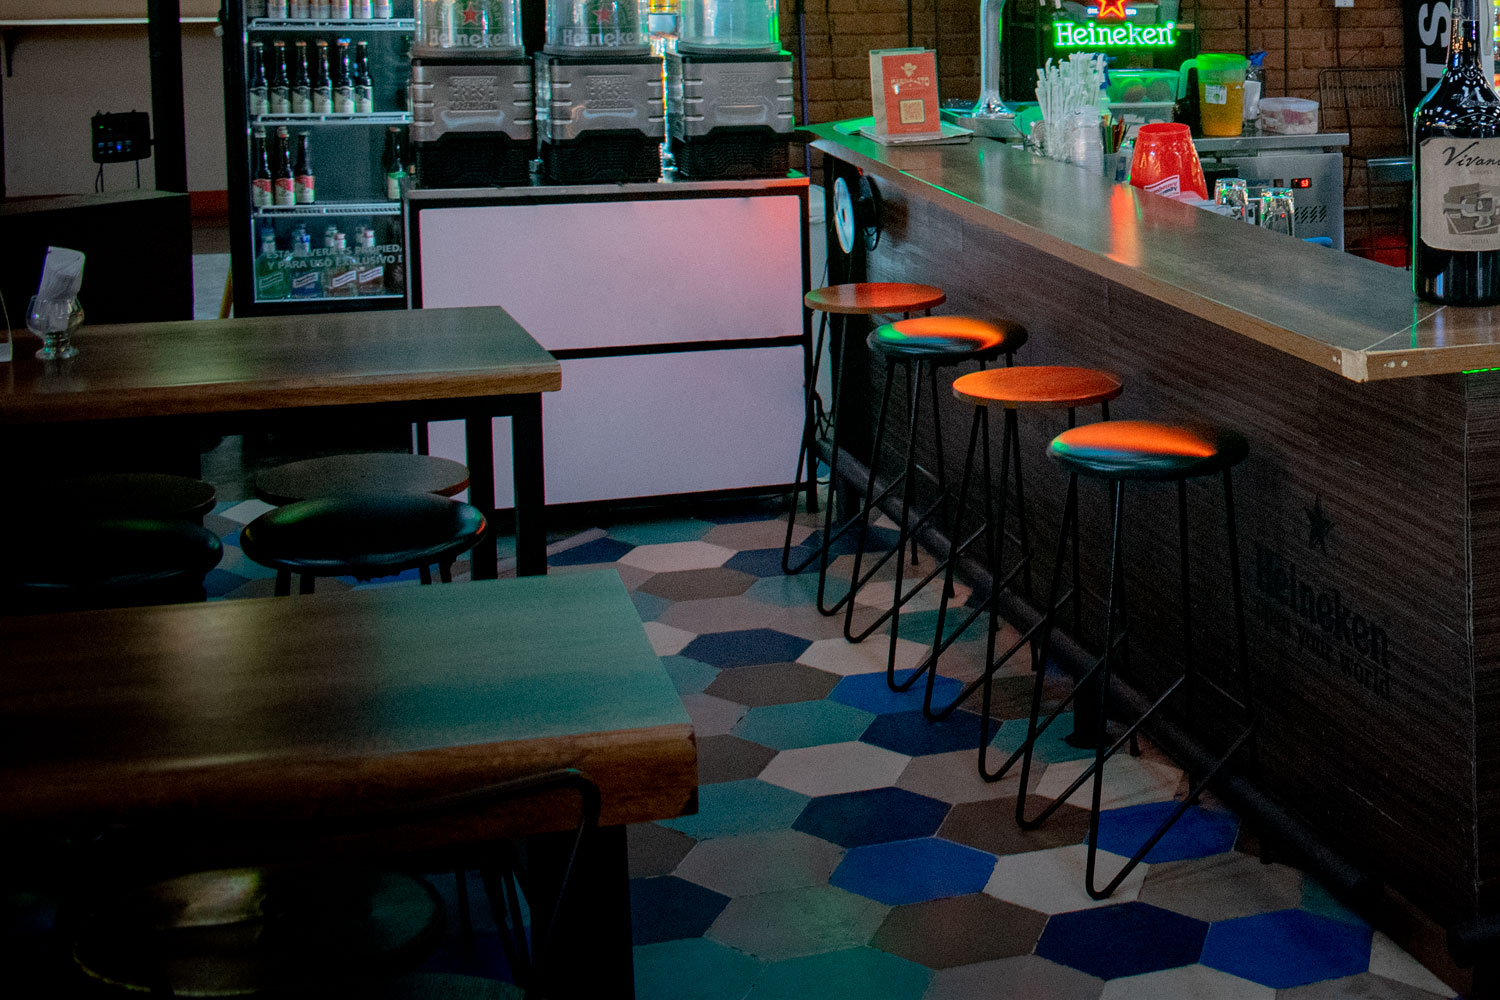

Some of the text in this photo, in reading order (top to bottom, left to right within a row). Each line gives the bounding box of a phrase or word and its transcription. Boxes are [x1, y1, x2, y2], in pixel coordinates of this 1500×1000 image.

[1055, 22, 1175, 46] Heineken
[278, 260, 307, 269] PARA
[1255, 543, 1390, 669] Heineken
